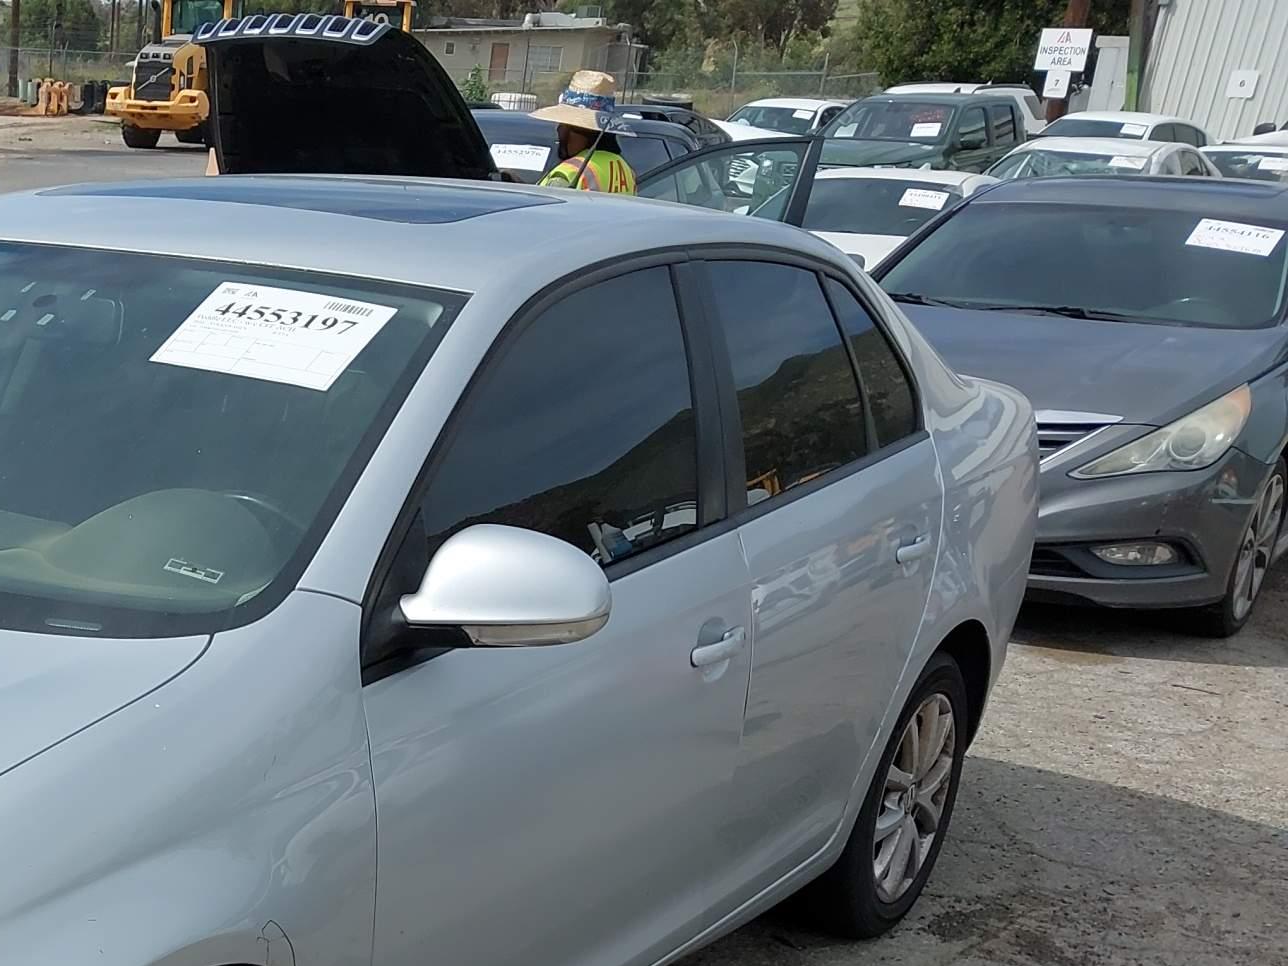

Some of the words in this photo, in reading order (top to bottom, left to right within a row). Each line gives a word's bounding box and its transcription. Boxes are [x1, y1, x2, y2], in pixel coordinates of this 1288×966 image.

[1039, 46, 1086, 56] INSPECTION
[1050, 57, 1072, 65] AREA
[1054, 79, 1060, 87] 7
[215, 301, 360, 335] 44553197
